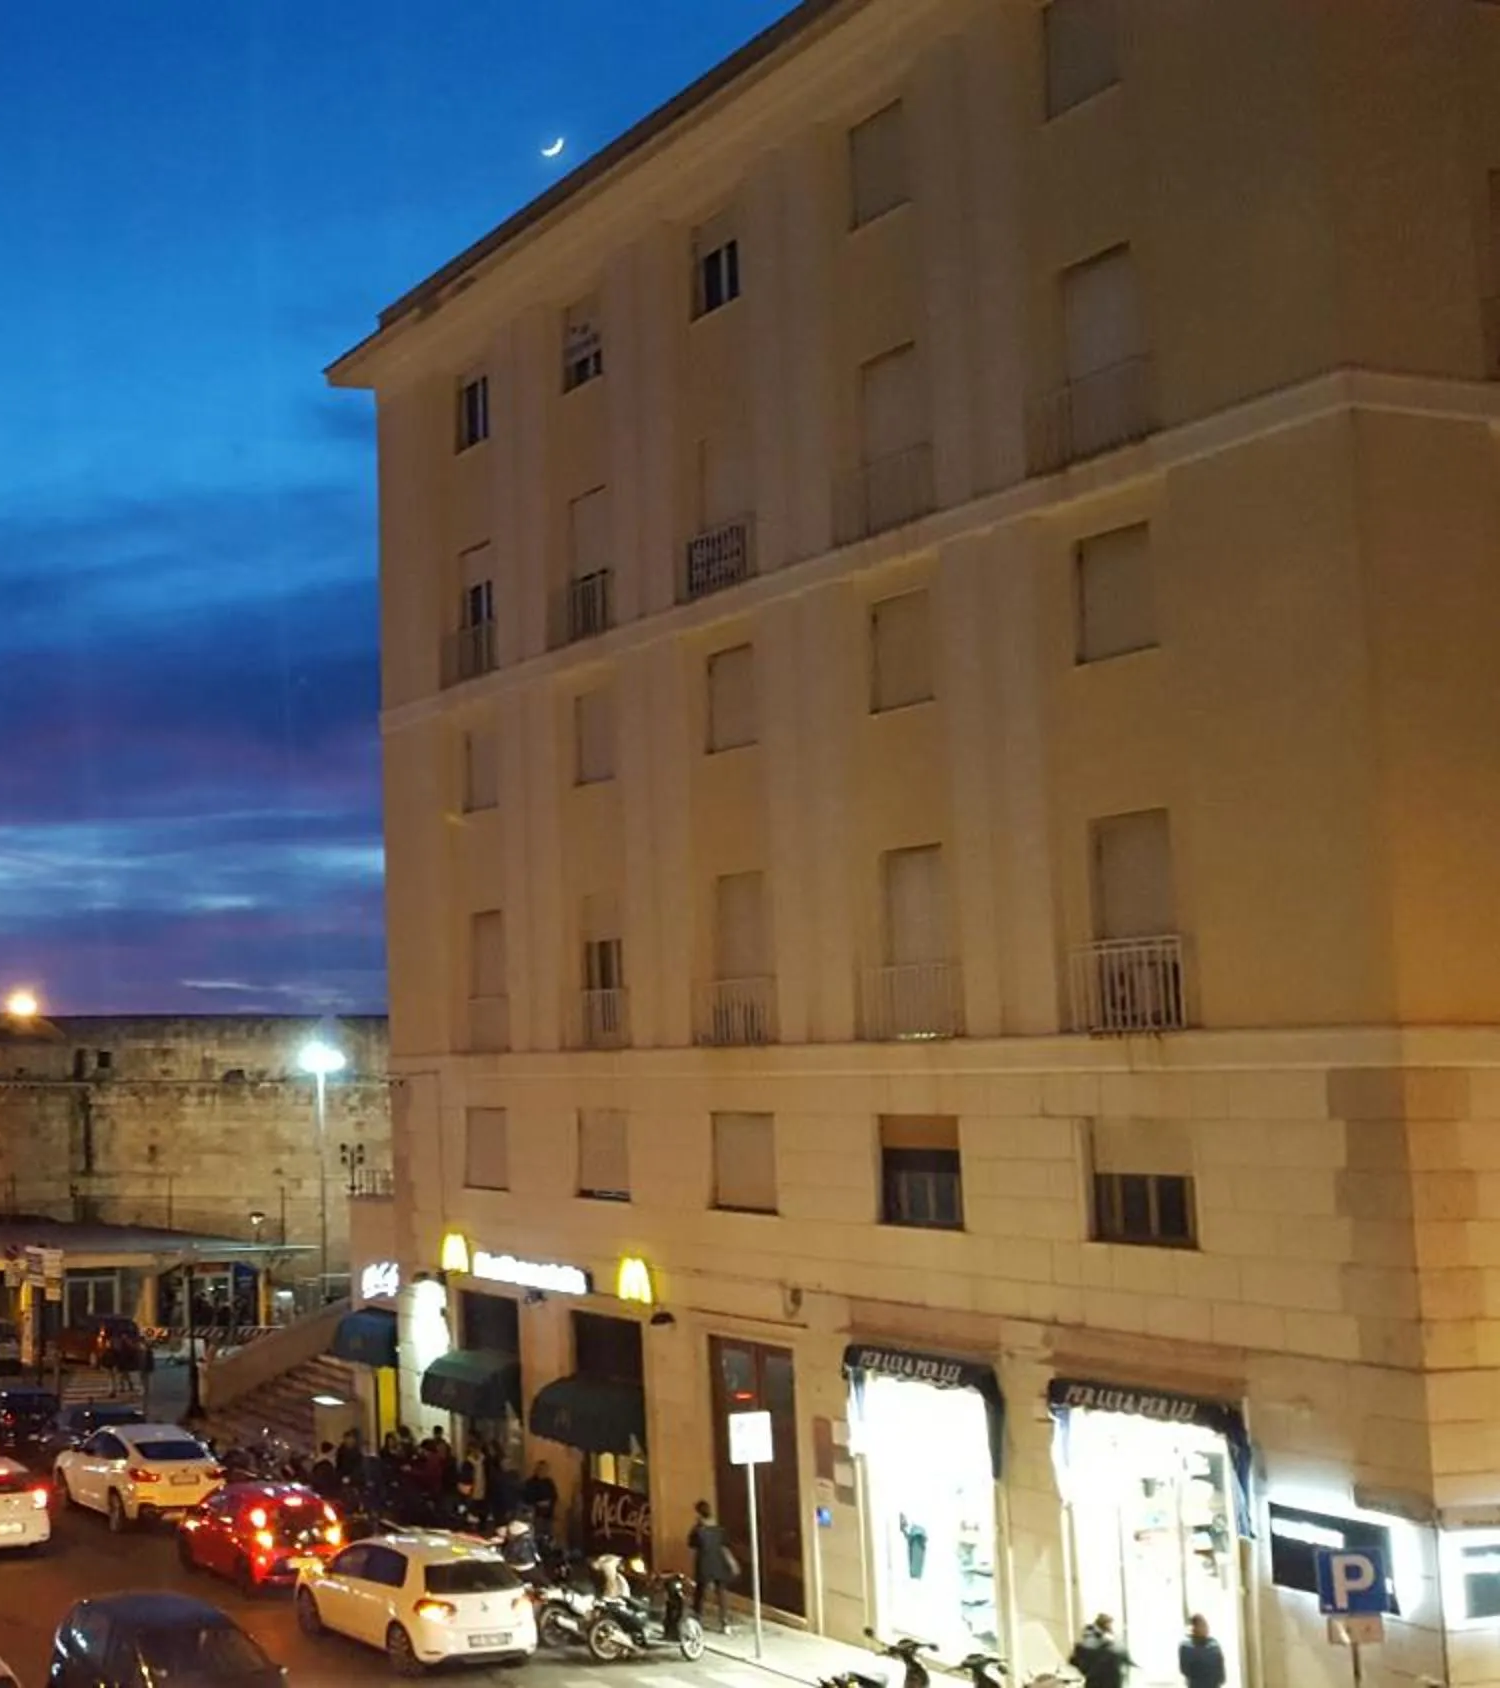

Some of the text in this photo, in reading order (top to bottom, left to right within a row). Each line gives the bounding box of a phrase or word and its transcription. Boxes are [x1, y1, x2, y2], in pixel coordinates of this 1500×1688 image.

[859, 1350, 881, 1367] PER
[916, 1359, 939, 1377] PER
[1065, 1385, 1095, 1405] PER
[1138, 1396, 1168, 1417] PER
[1331, 1554, 1375, 1610] P
